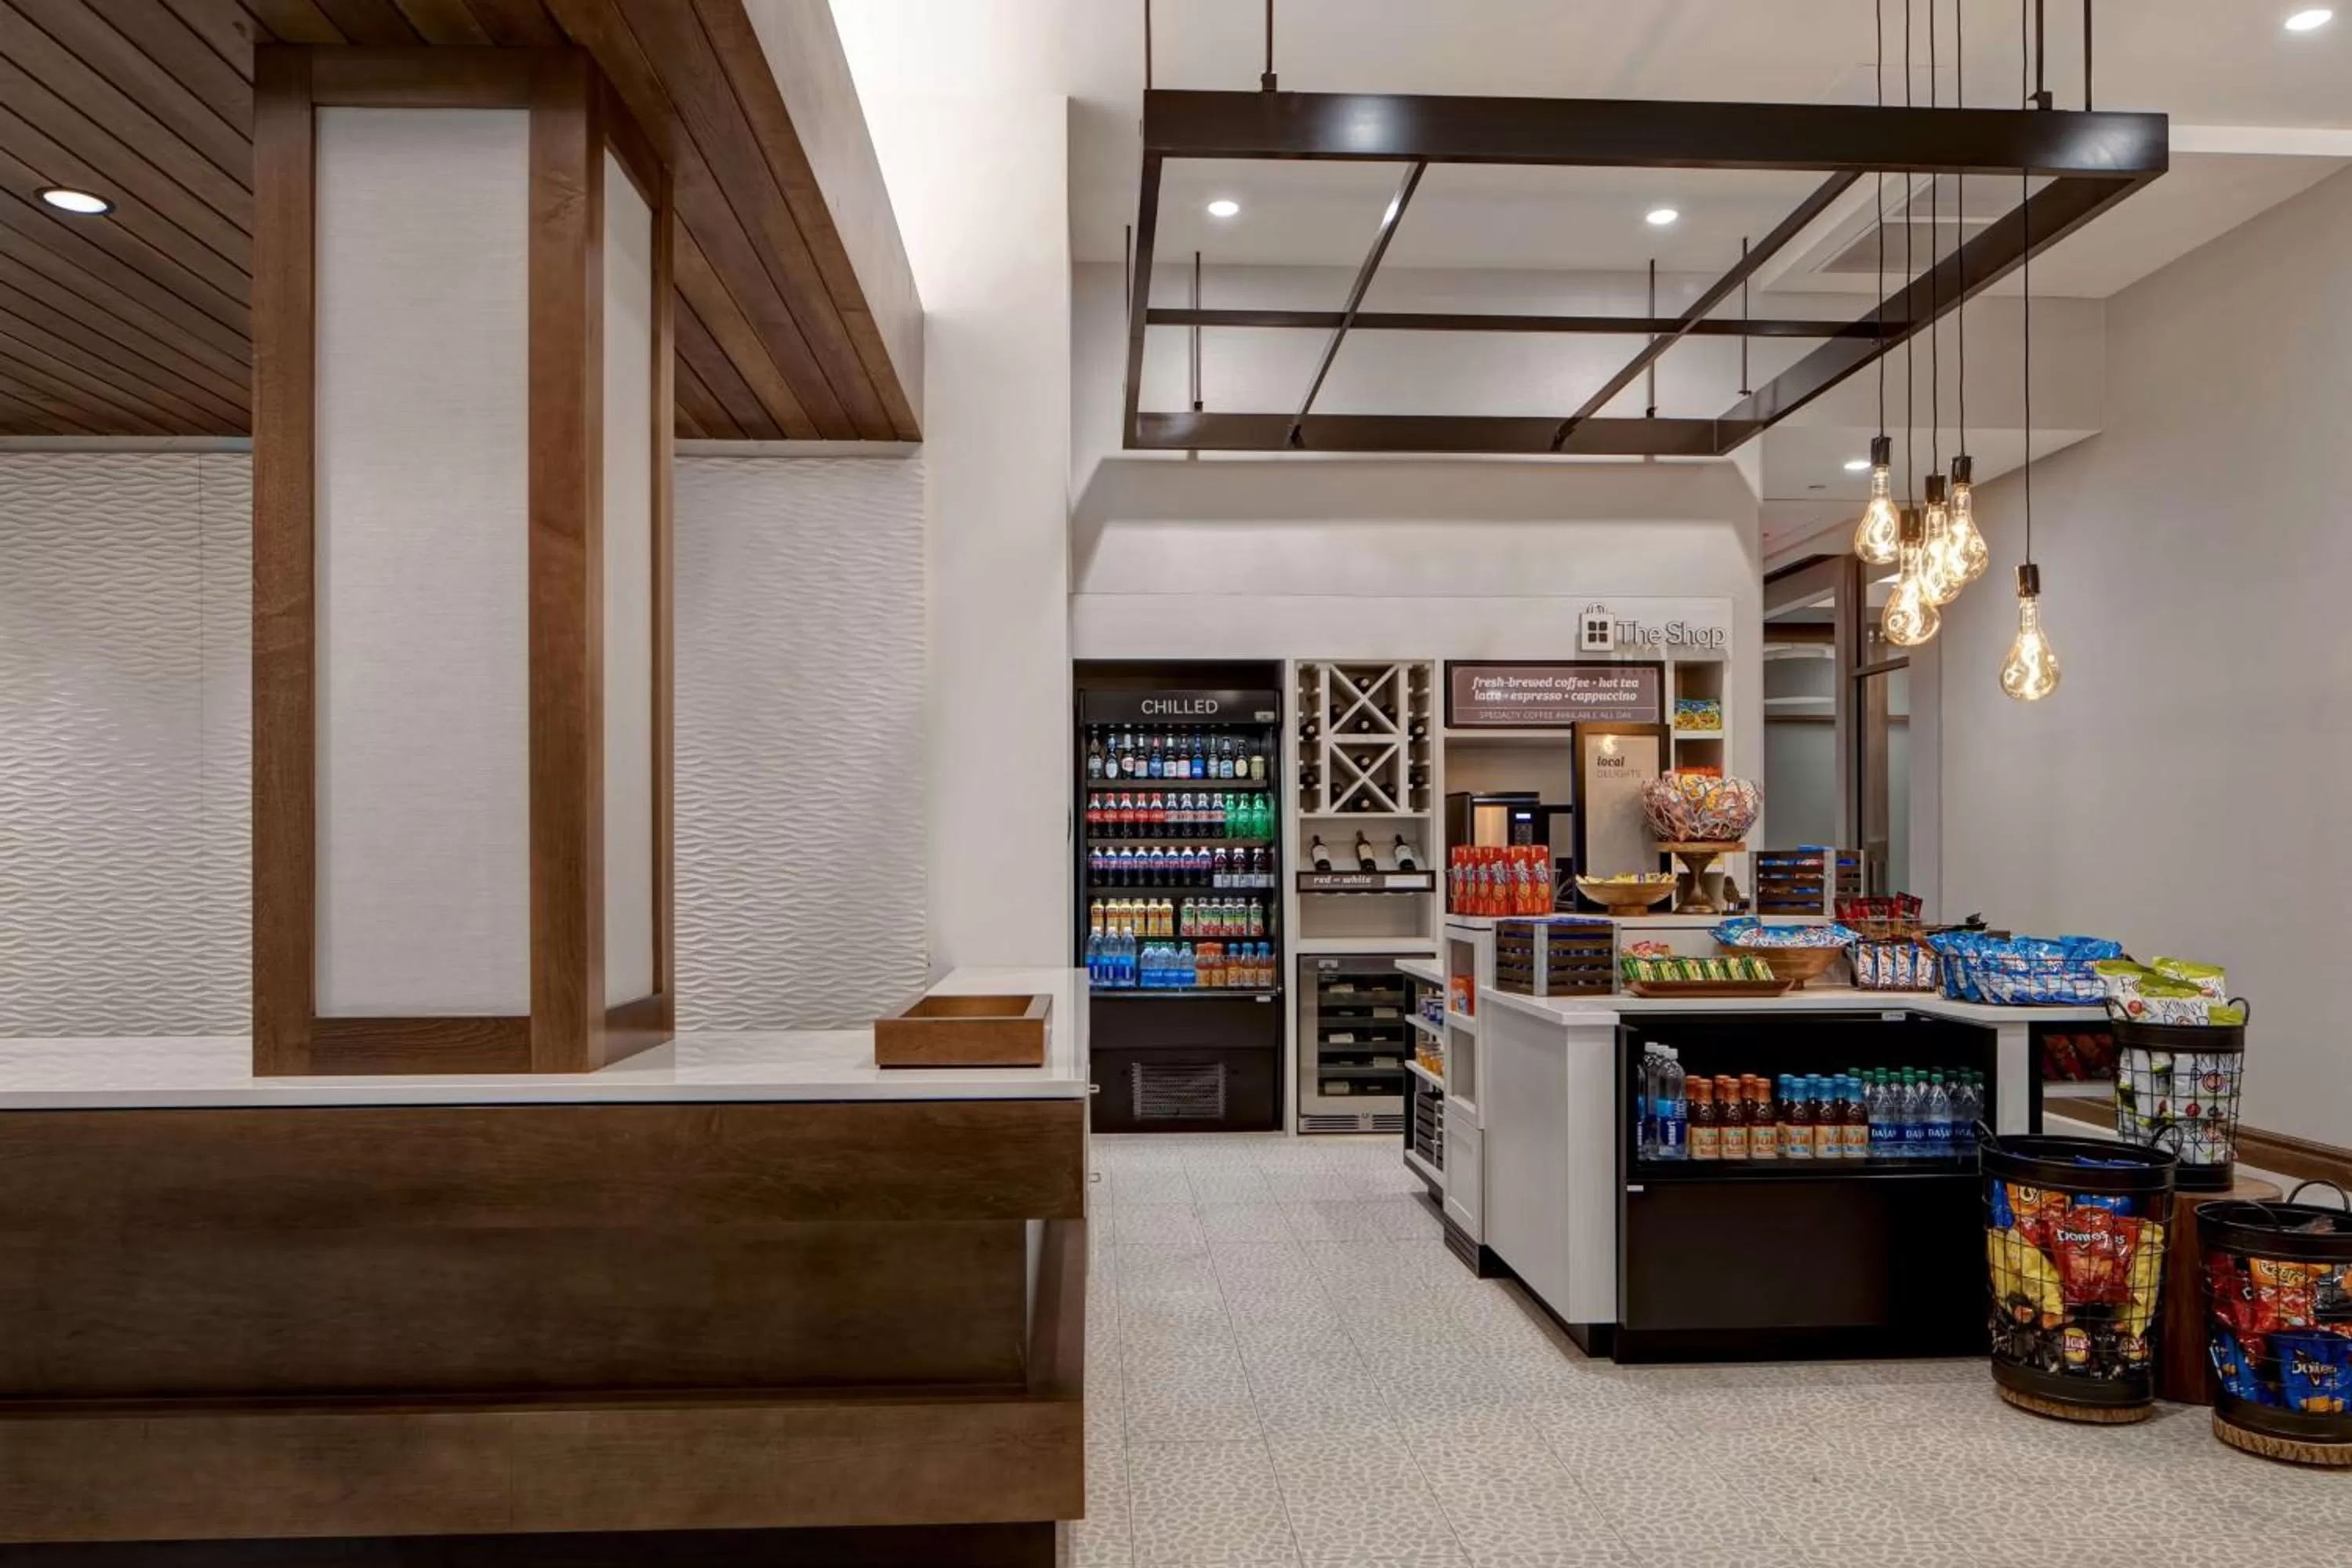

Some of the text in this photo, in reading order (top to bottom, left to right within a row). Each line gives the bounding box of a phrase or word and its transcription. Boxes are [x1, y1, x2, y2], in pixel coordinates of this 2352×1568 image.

[1616, 620, 1725, 649] The Shop
[1472, 677, 1639, 690] fresh-brewed coffee hot tea
[1475, 689, 1637, 703] latte espresso cappuccino
[1141, 699, 1218, 714] CHILLED
[1597, 755, 1625, 767] local
[1596, 768, 1642, 779] DELIGHTS
